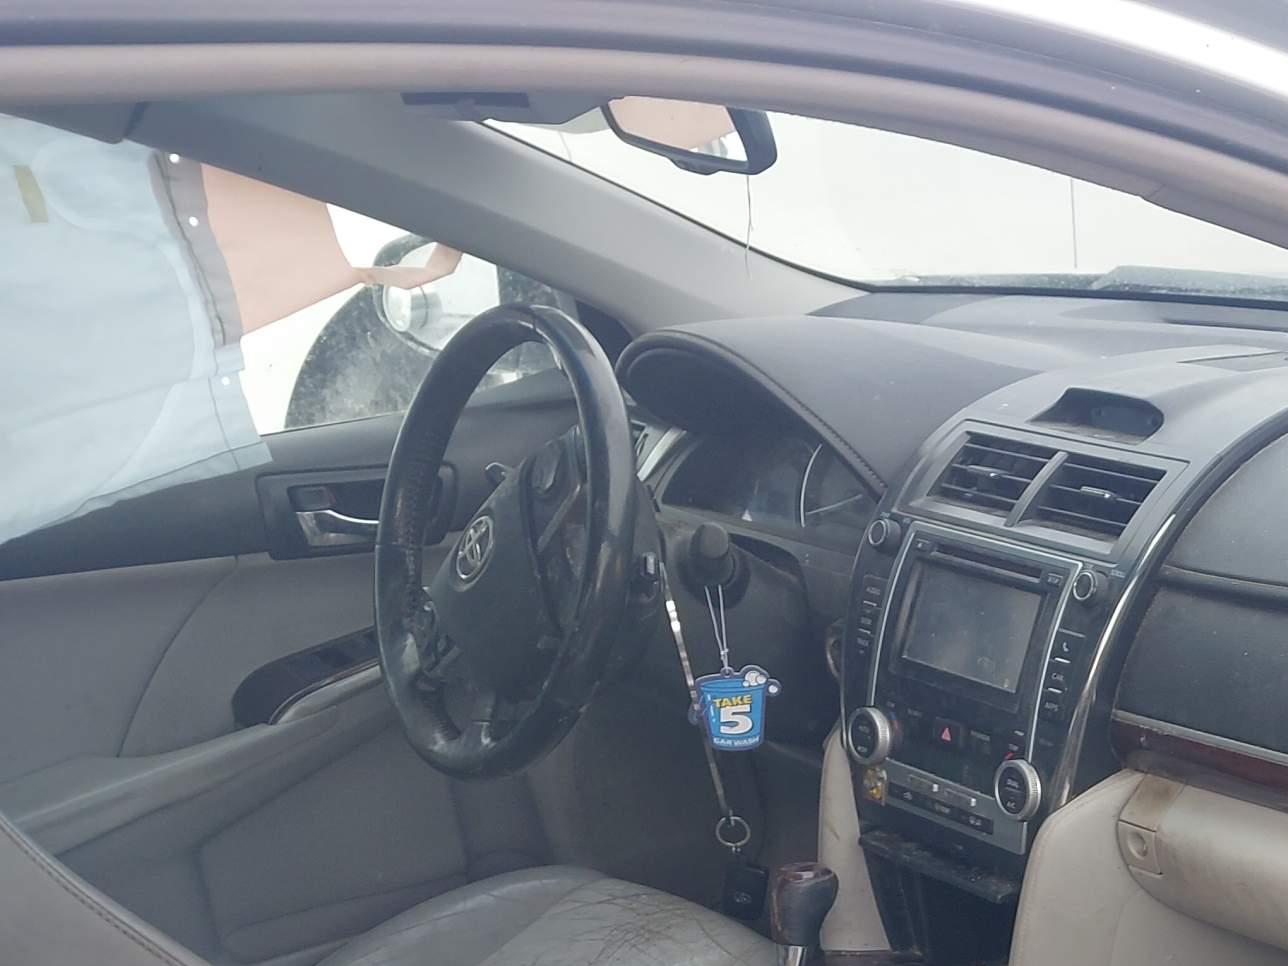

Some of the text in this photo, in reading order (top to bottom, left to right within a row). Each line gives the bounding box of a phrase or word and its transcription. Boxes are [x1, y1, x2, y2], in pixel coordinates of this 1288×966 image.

[713, 694, 752, 708] TAKE
[720, 704, 753, 735] 5
[713, 736, 760, 747] CAR WASH
